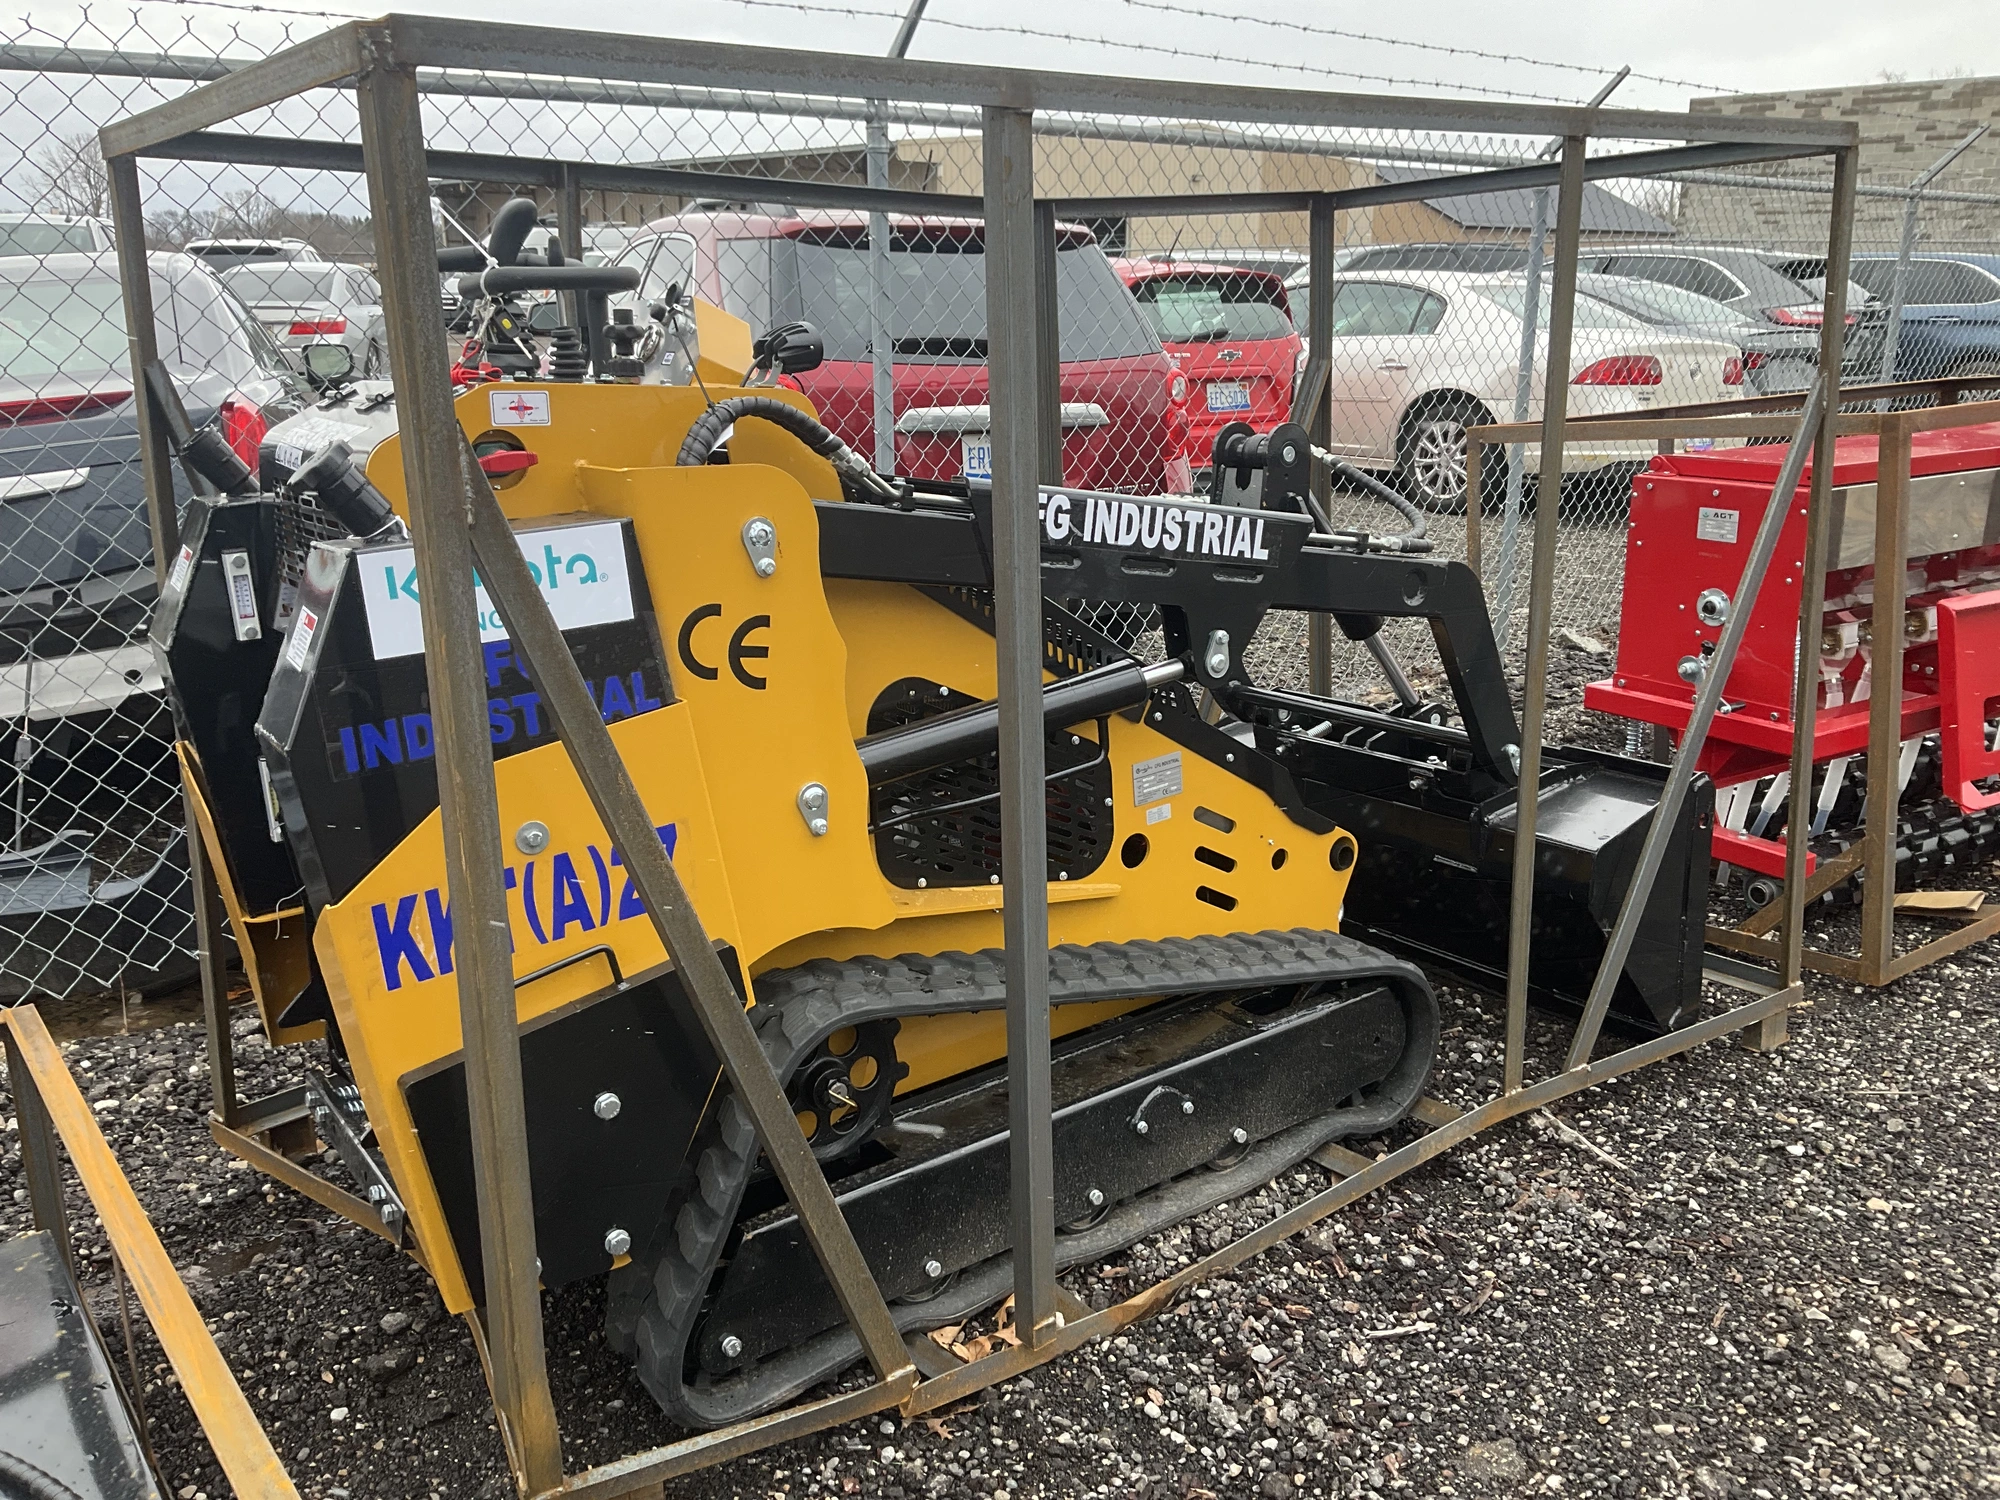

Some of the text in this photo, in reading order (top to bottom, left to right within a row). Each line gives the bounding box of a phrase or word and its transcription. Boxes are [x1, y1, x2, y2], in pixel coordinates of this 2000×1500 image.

[1083, 498, 1269, 560] INDUSTRIAL
[1713, 512, 1734, 520] AGT
[678, 603, 771, 690] CE
